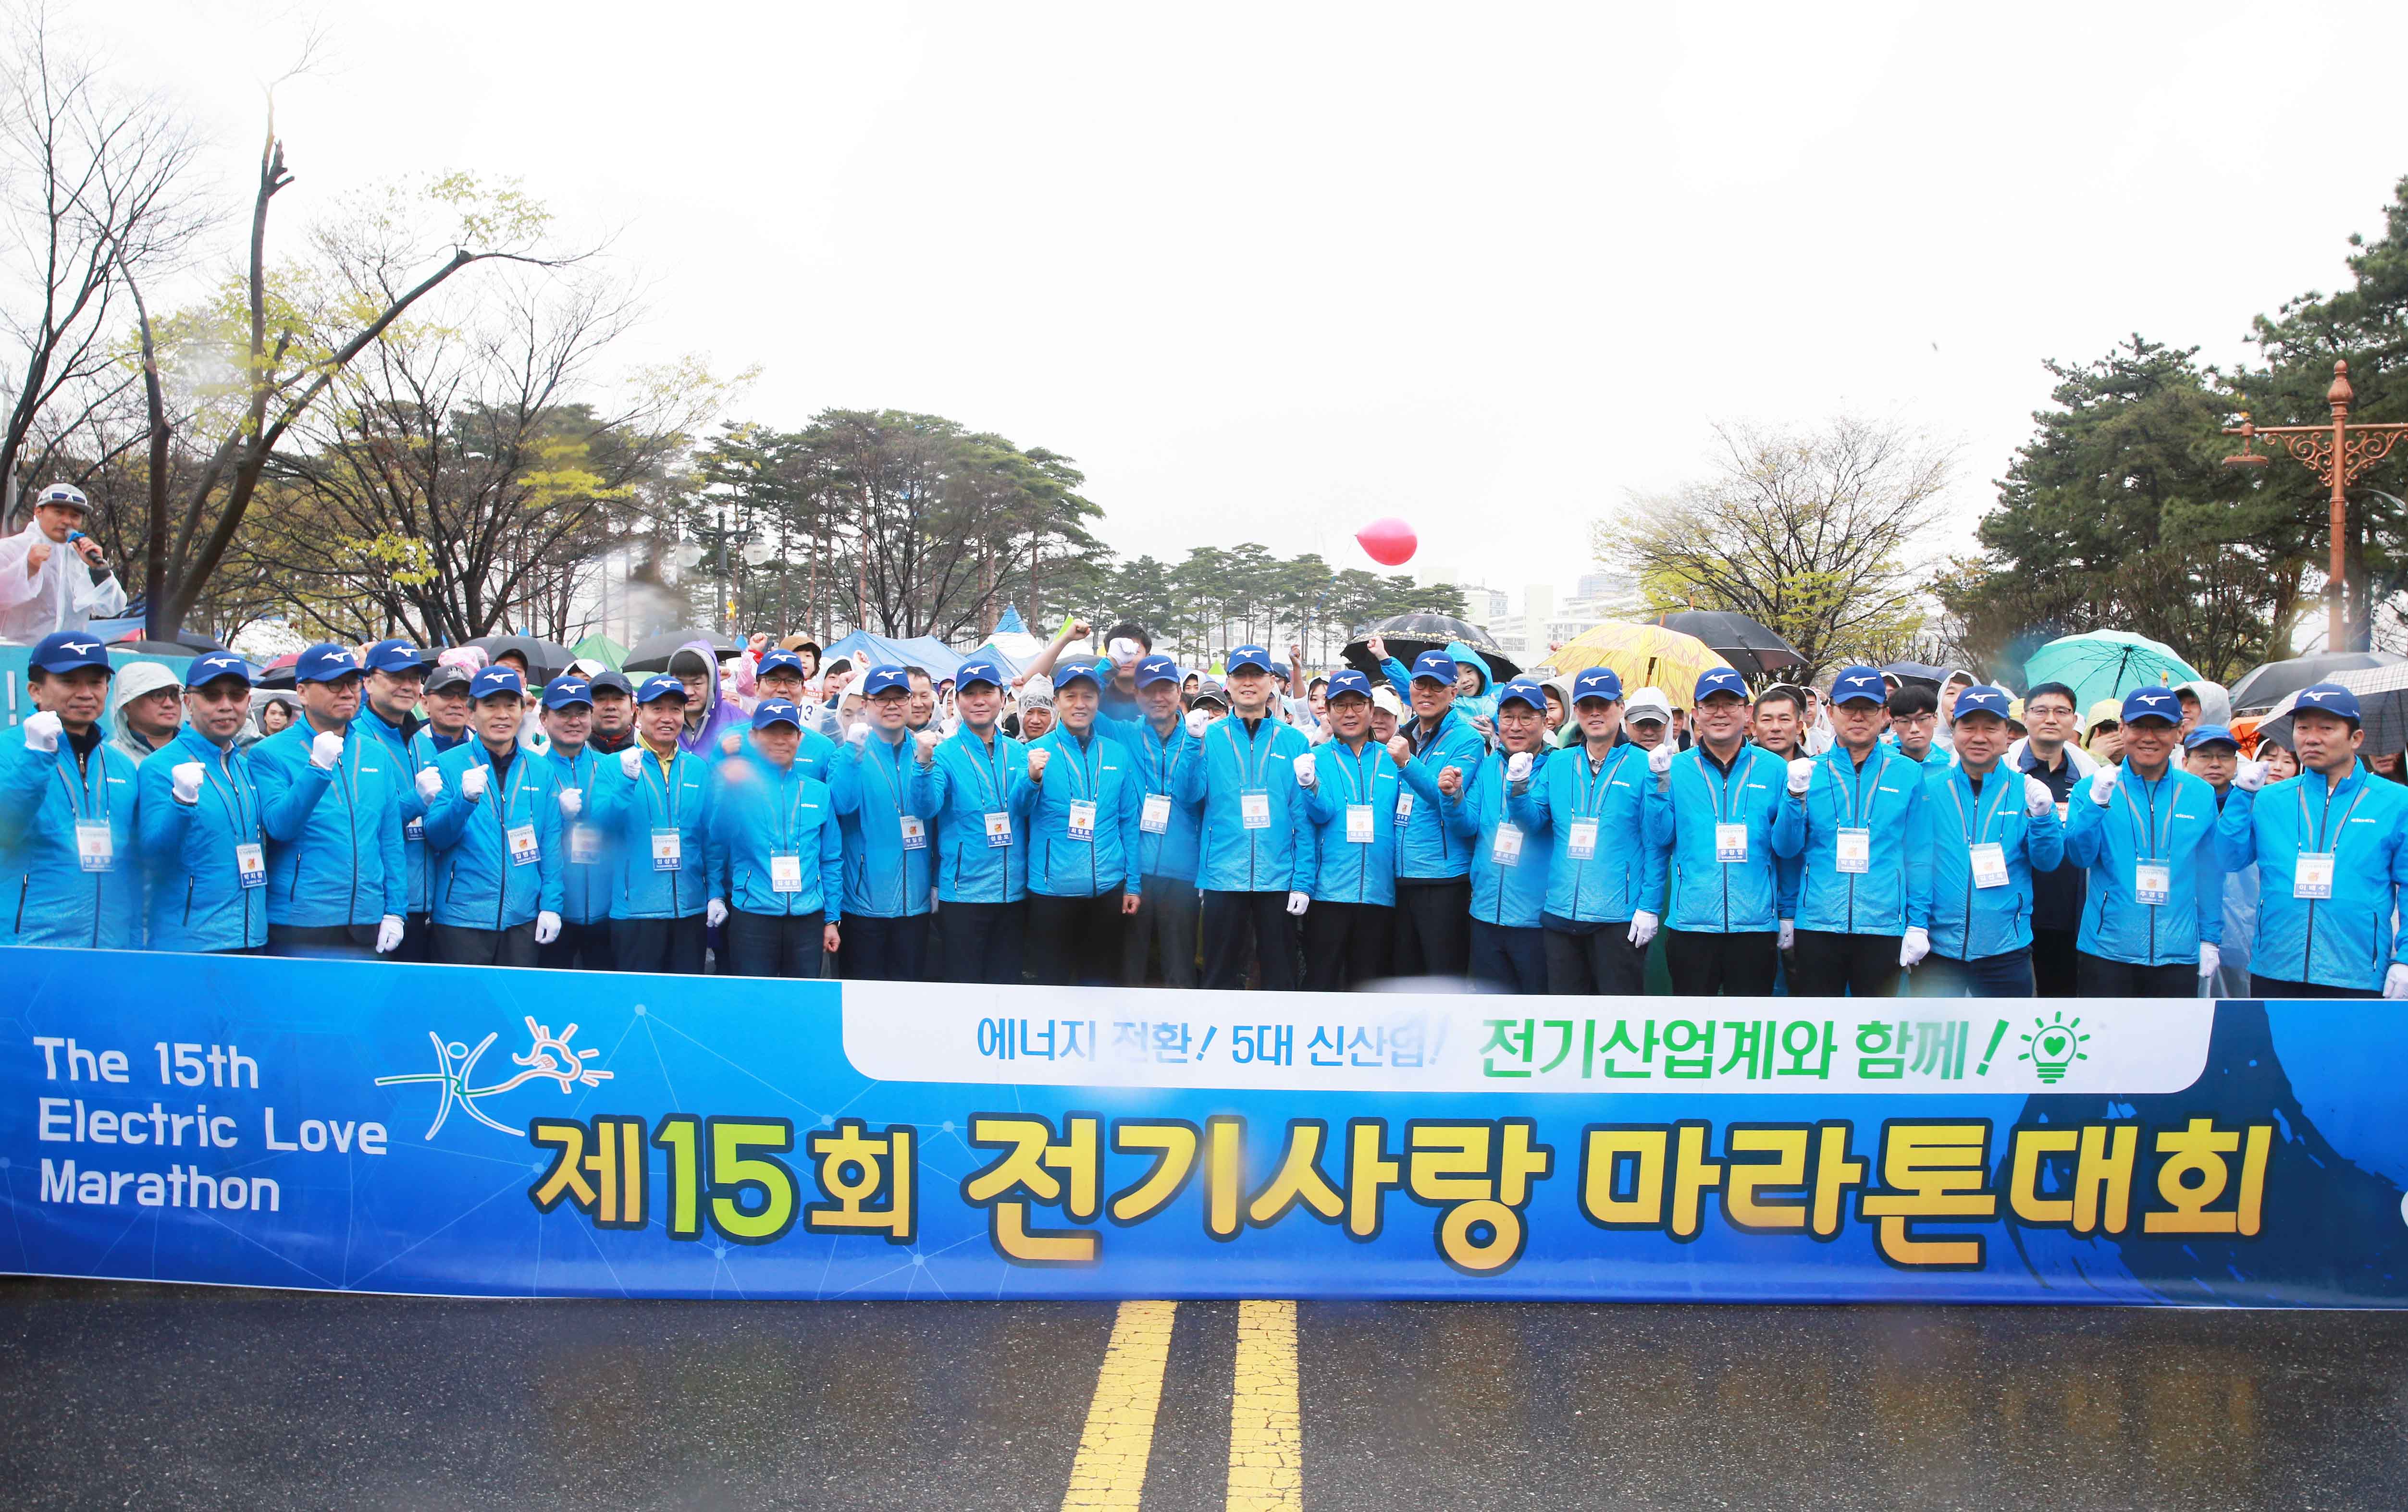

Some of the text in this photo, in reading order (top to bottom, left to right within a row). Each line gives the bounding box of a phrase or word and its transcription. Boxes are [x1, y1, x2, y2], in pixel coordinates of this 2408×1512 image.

[34, 1036, 259, 1089] The 15th
[977, 1015, 2010, 1080] 에너지 전환! 5대 신산업! 전기산업계와 함께!
[38, 1096, 388, 1155] Electric Love
[40, 1158, 280, 1212] Marathon
[528, 1110, 2279, 1277] 제15회 전기사랑 마라톤대회
